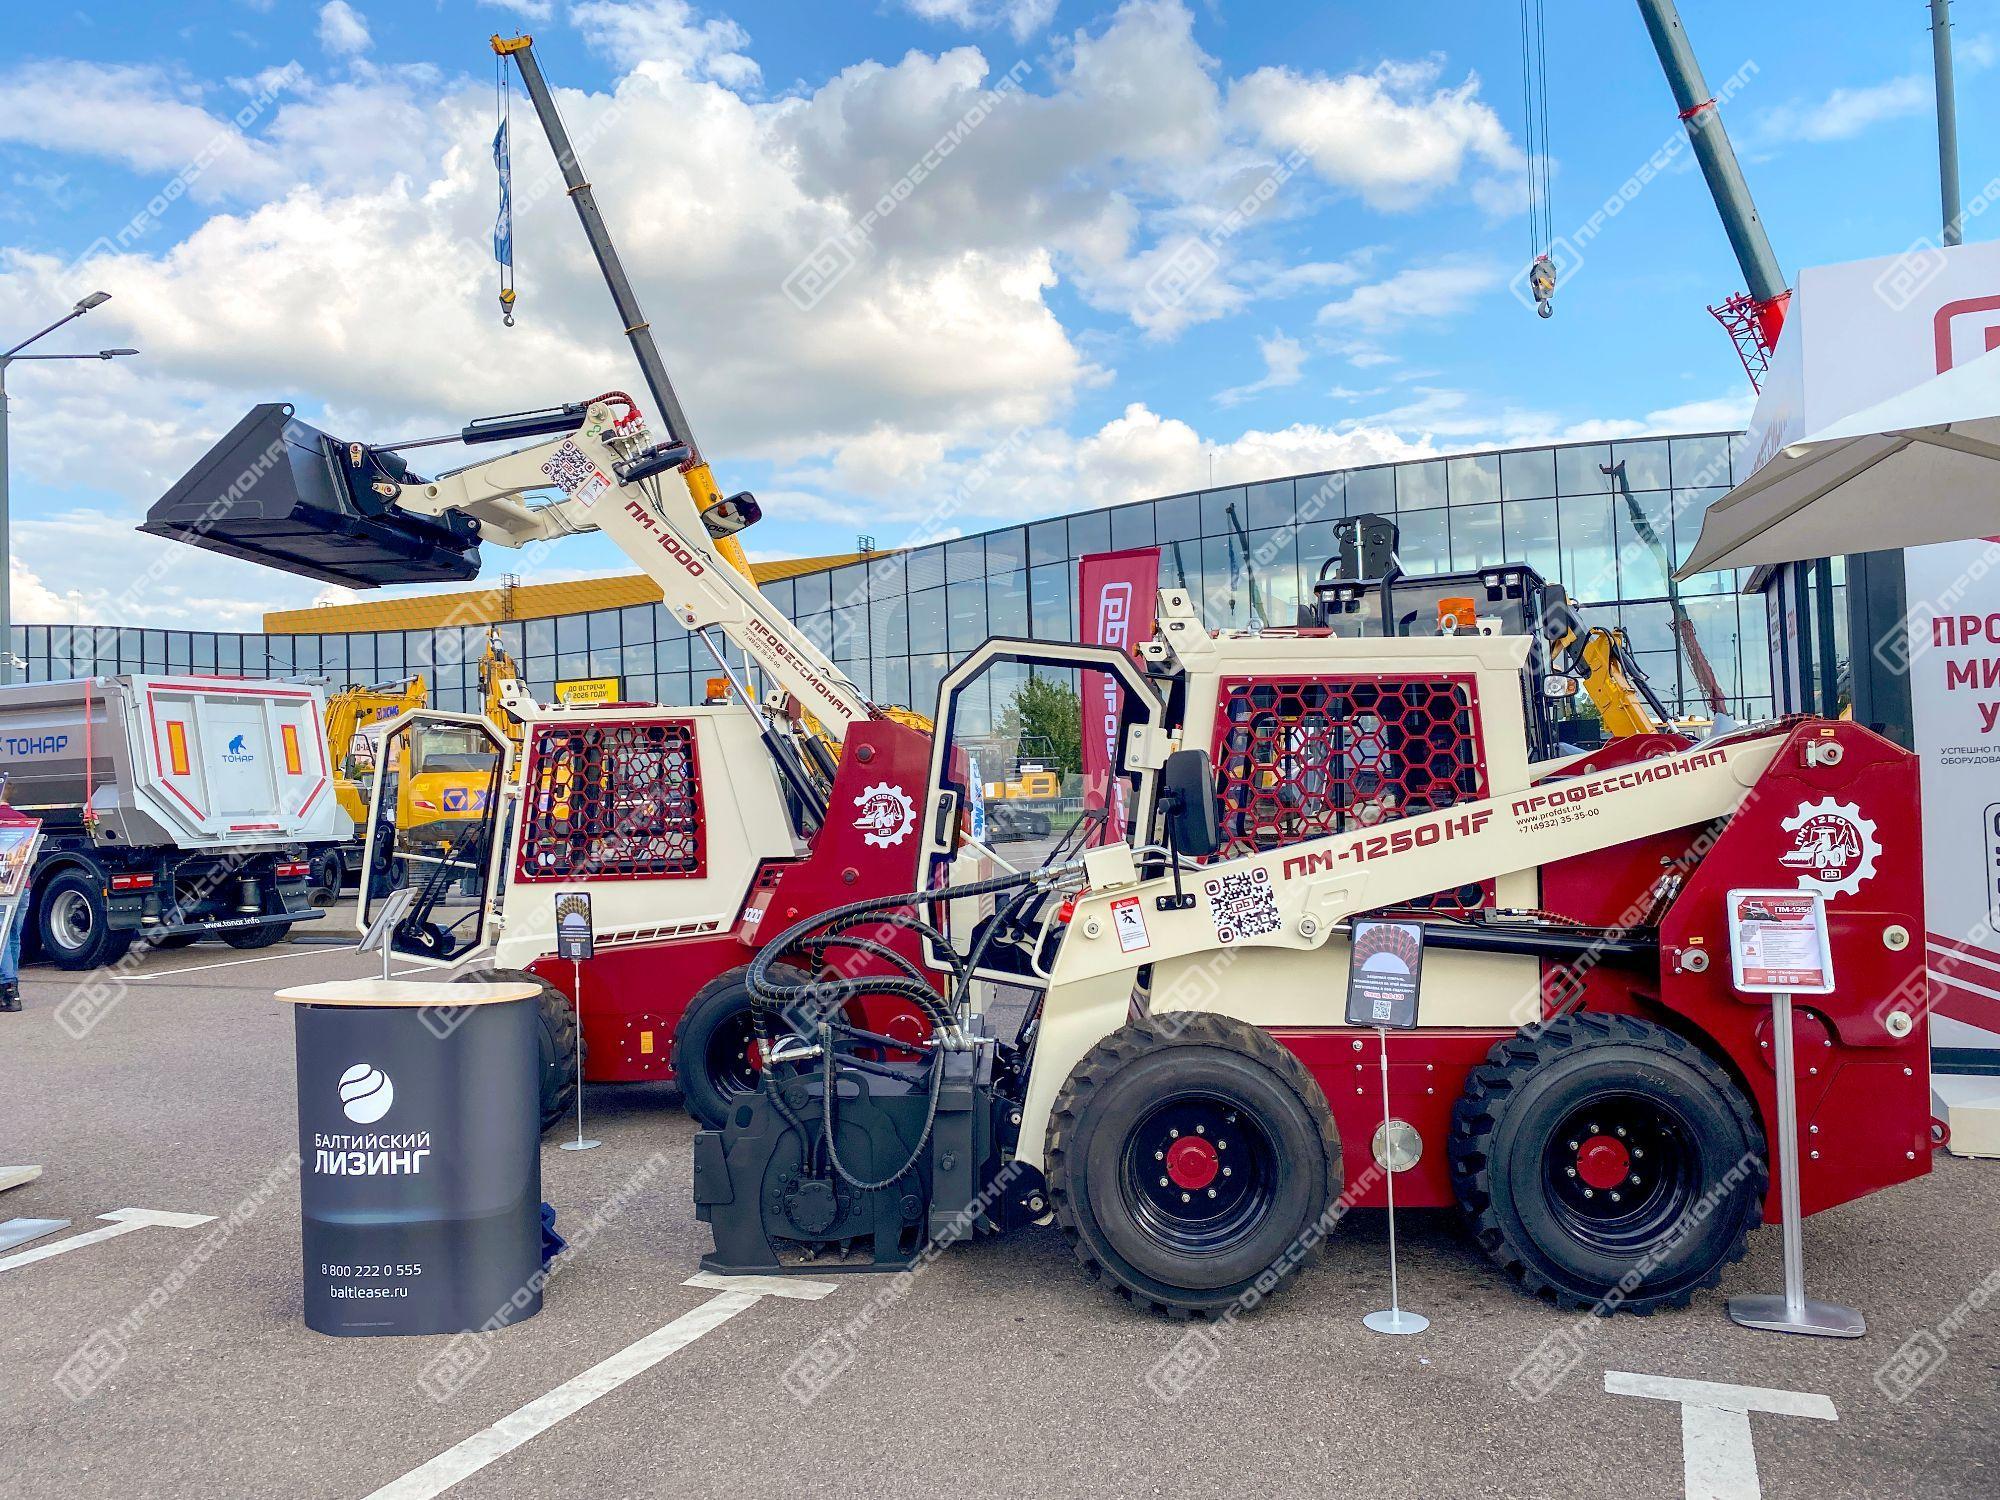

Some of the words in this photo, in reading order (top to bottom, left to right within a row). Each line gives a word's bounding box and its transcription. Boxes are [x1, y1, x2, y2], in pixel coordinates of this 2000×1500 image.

[624, 501, 704, 577] ПМ-1000
[750, 619, 852, 719] ПРОФЕССИОНАЛ
[6, 735, 68, 755] ТОНАР
[1940, 746, 1991, 755] УСПЕШНО
[222, 755, 254, 763] ТОНАР
[1512, 750, 1727, 816] ПРОФЕССИОНАЛ
[1516, 804, 1581, 825] www.profdst.ru
[1530, 819, 1559, 832] (4932)
[1560, 808, 1600, 824] 35-35-00
[1794, 815, 1846, 846] ПМ-1250
[203, 917, 260, 928] www.tonar.info
[743, 907, 764, 924] 1000
[315, 1131, 430, 1148] БАЛТИЙСКИЙ
[314, 1149, 430, 1176] ЛИЗИНГ
[321, 1263, 328, 1275] 8
[329, 1264, 351, 1277] 800
[354, 1265, 380, 1277] 222
[383, 1264, 392, 1276] 0
[396, 1263, 422, 1276] 555
[330, 1284, 408, 1299] baltlease.ru
